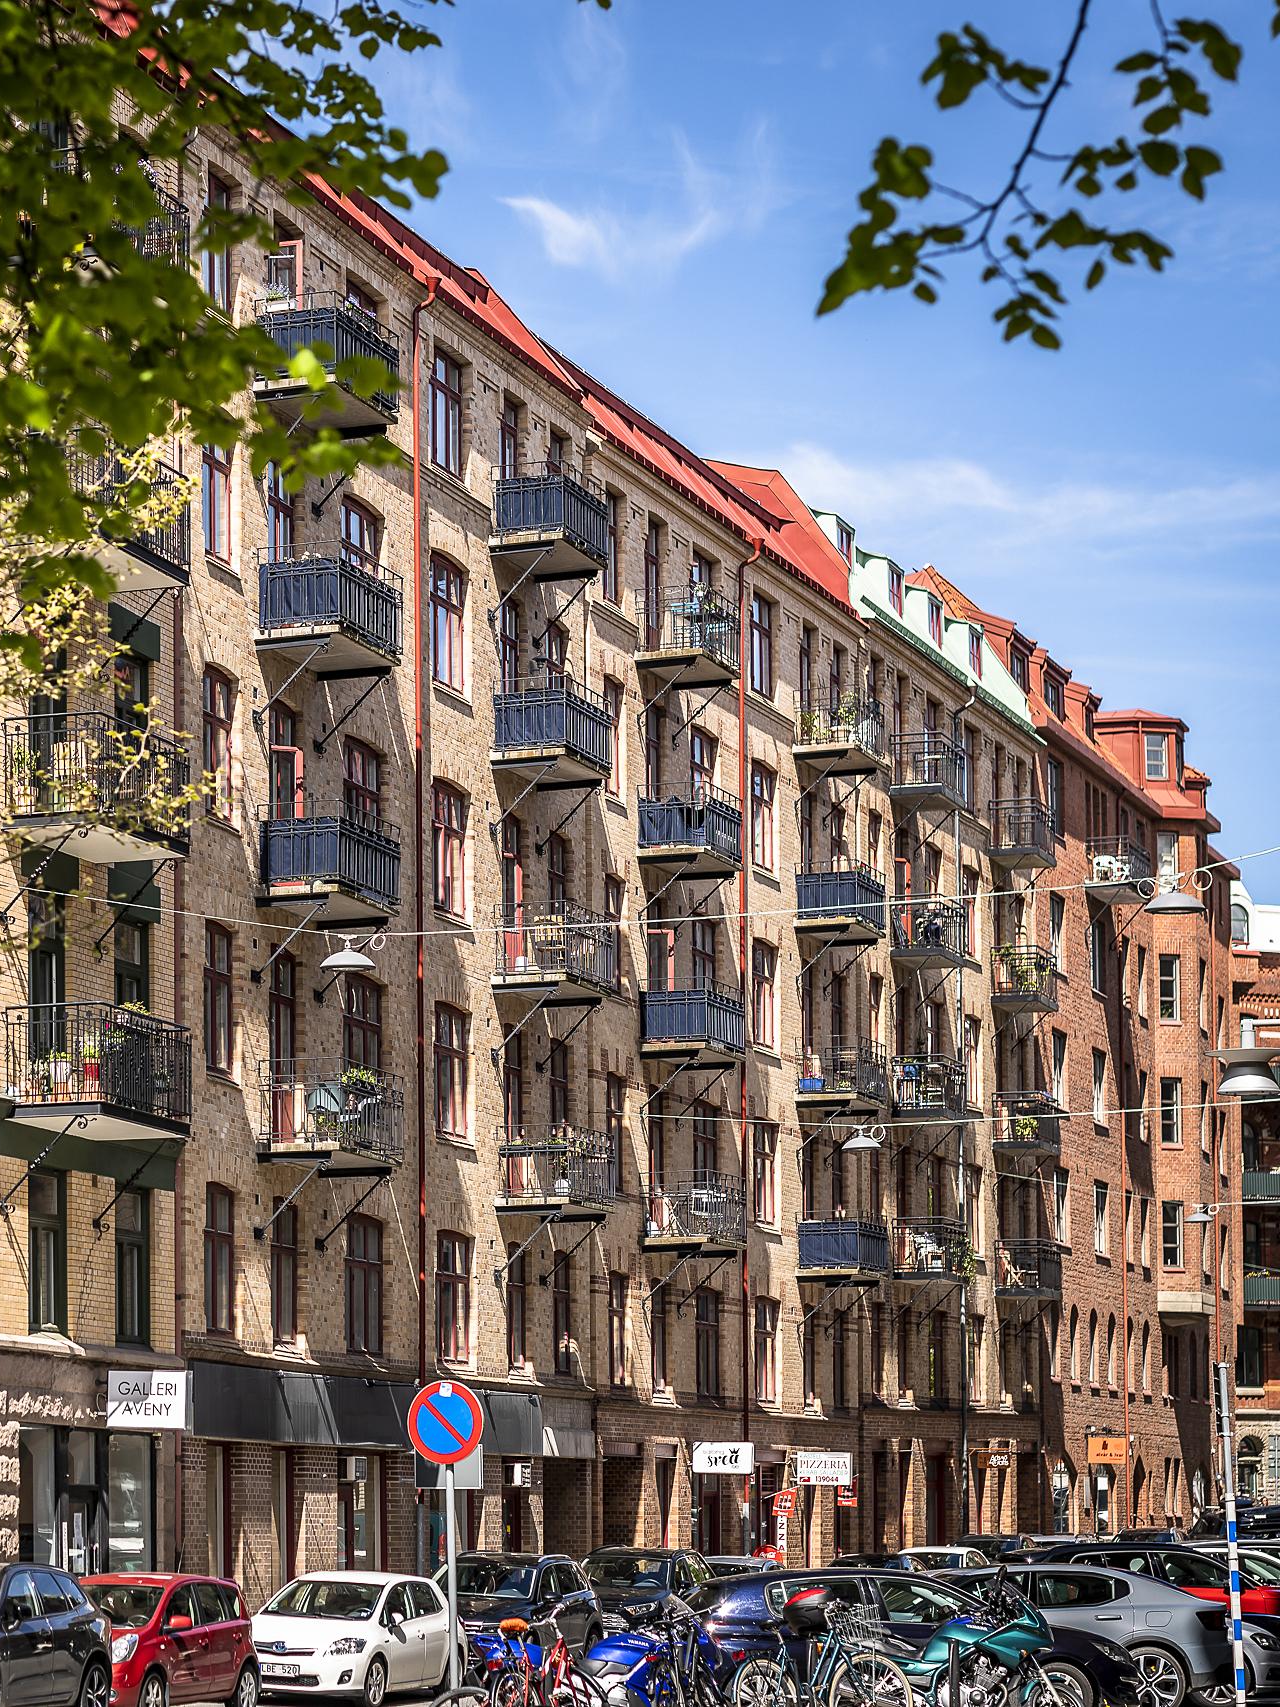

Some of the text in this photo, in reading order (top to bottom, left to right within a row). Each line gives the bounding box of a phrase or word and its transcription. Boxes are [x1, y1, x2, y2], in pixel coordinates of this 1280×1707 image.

[118, 1381, 177, 1396] GALLERI
[122, 1402, 172, 1416] AVENY
[800, 1460, 848, 1469] PIZZERIA
[628, 1639, 650, 1648] YAMAHA
[261, 1663, 276, 1673] LBE
